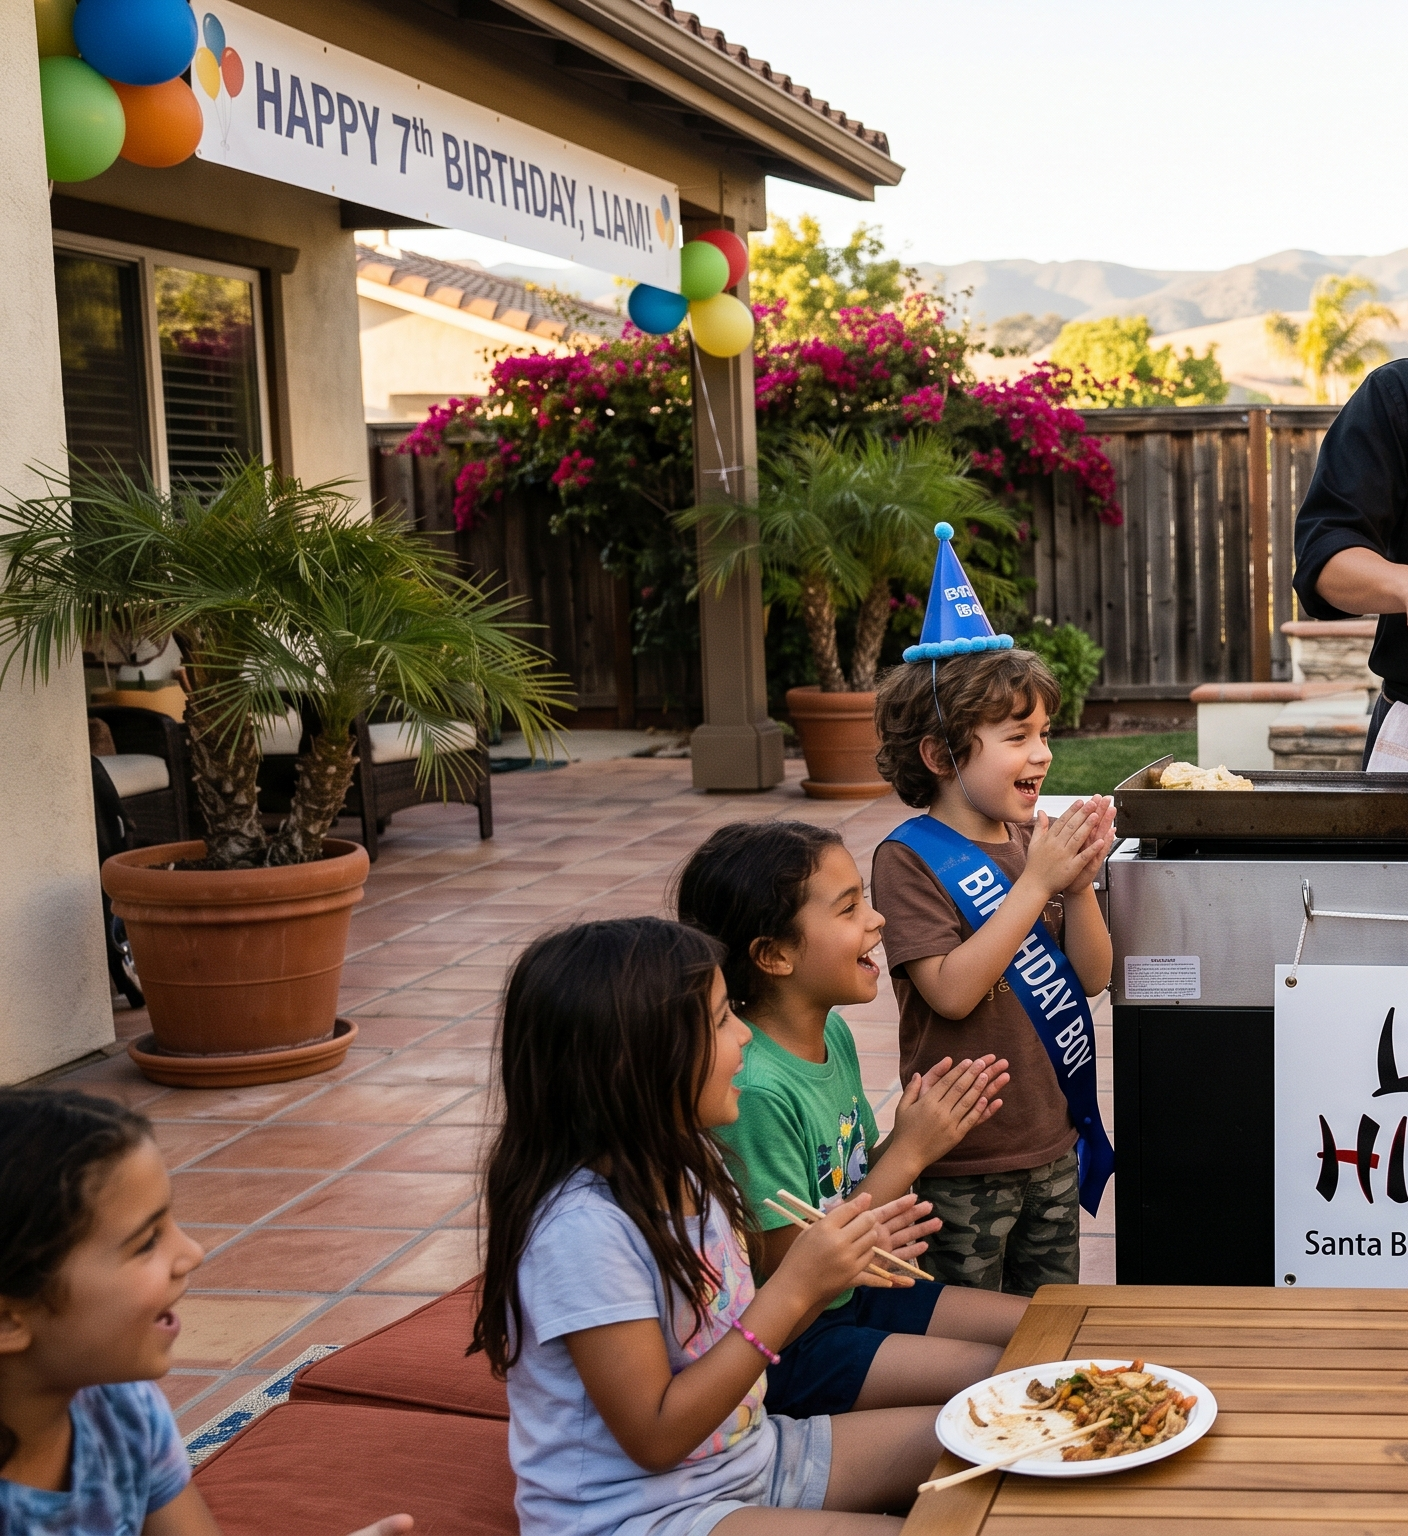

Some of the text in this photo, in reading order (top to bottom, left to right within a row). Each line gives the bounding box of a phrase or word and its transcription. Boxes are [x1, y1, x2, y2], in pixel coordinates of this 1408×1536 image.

[254, 60, 653, 254] HAPPY 7th BIRTHDAY, LIAM!
[1055, 1015, 1092, 1078] BOY
[1304, 1230, 1382, 1257] Santa
